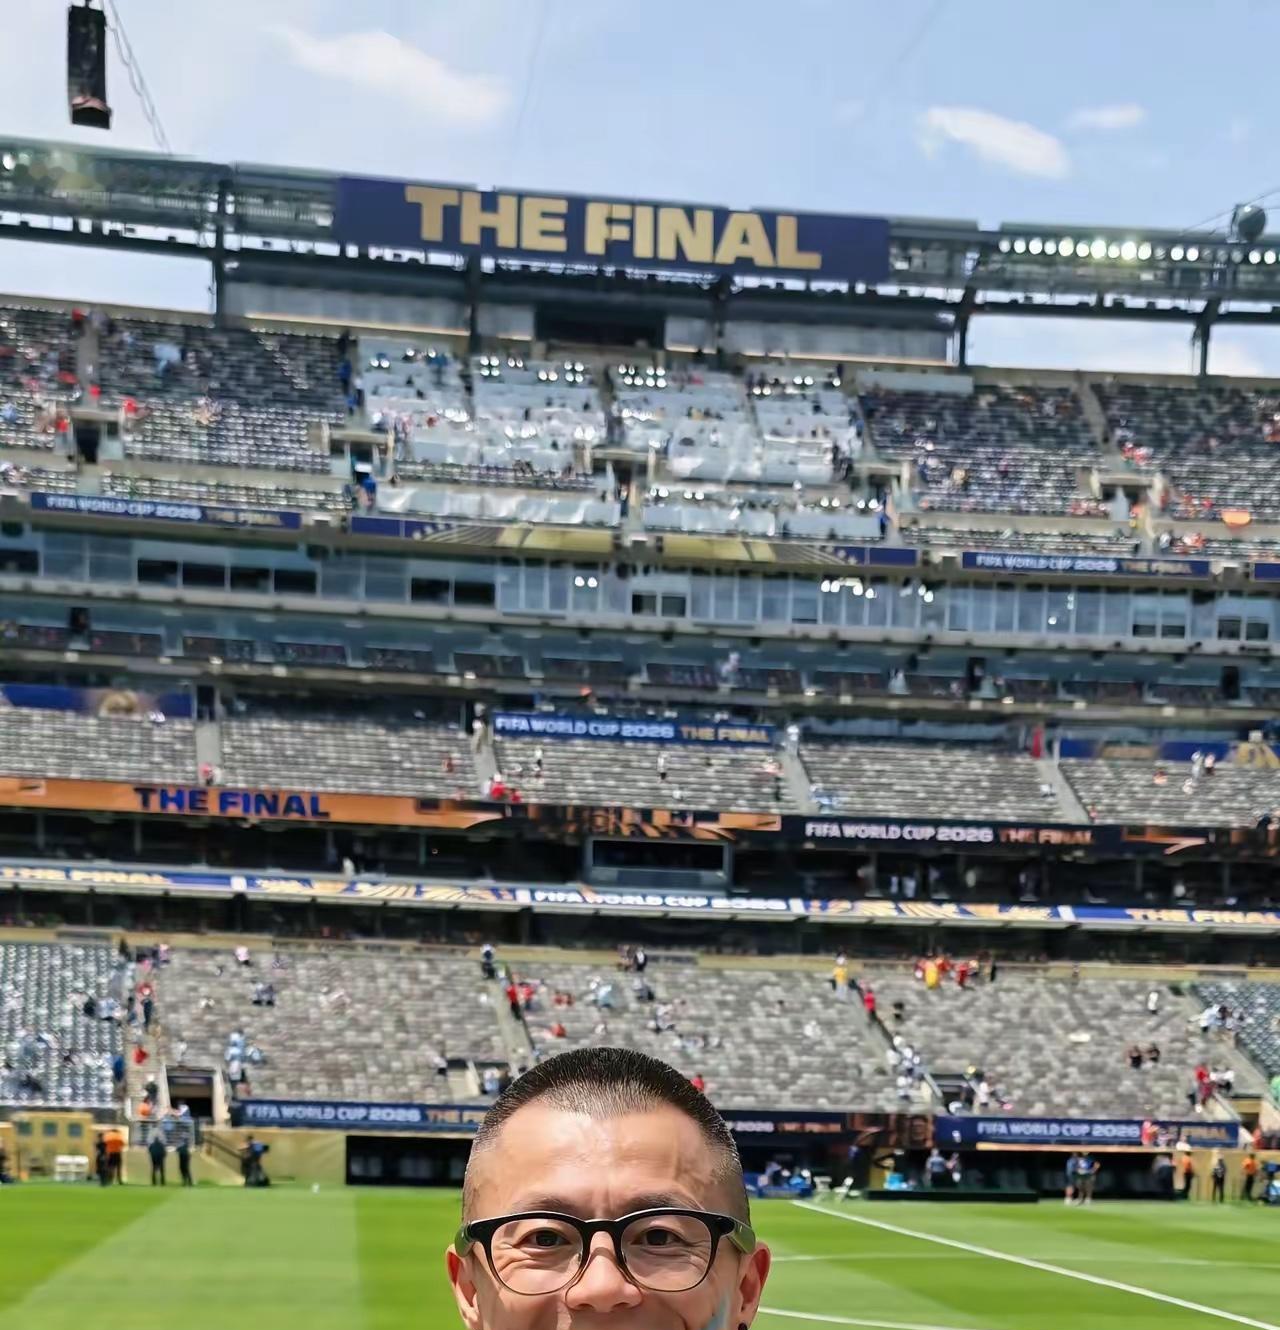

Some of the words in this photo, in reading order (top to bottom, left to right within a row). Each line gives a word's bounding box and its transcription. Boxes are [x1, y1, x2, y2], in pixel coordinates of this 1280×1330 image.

[405, 186, 568, 252] THE
[584, 200, 822, 271] FINAL
[156, 504, 201, 520] 2026
[1074, 559, 1116, 571] 2026
[495, 717, 530, 732] FIFA
[531, 719, 587, 735] WORLD
[588, 723, 618, 737] CUP
[621, 725, 675, 739] 2026
[681, 726, 715, 741] THE
[717, 728, 769, 743] FINAL
[134, 787, 208, 811] THE
[219, 790, 330, 818] FINAL
[805, 822, 841, 838] FIFA
[842, 823, 901, 840] WORLD
[902, 825, 936, 841] CUP
[936, 826, 993, 843] 2026
[998, 828, 1036, 844] THE
[1038, 829, 1093, 845] FINAL
[534, 891, 582, 903] FIFA
[585, 892, 663, 905] WORLD
[664, 896, 708, 907] CUP
[1126, 908, 1190, 922] THE
[246, 1105, 280, 1119] FIFA
[281, 1106, 335, 1120] WORLD
[337, 1106, 367, 1121] CUP
[368, 1107, 421, 1122] 2026
[977, 1122, 1008, 1135] FIFA
[1009, 1122, 1060, 1136] WORLD
[1062, 1124, 1090, 1137] CUP
[1092, 1126, 1140, 1138] 2026
